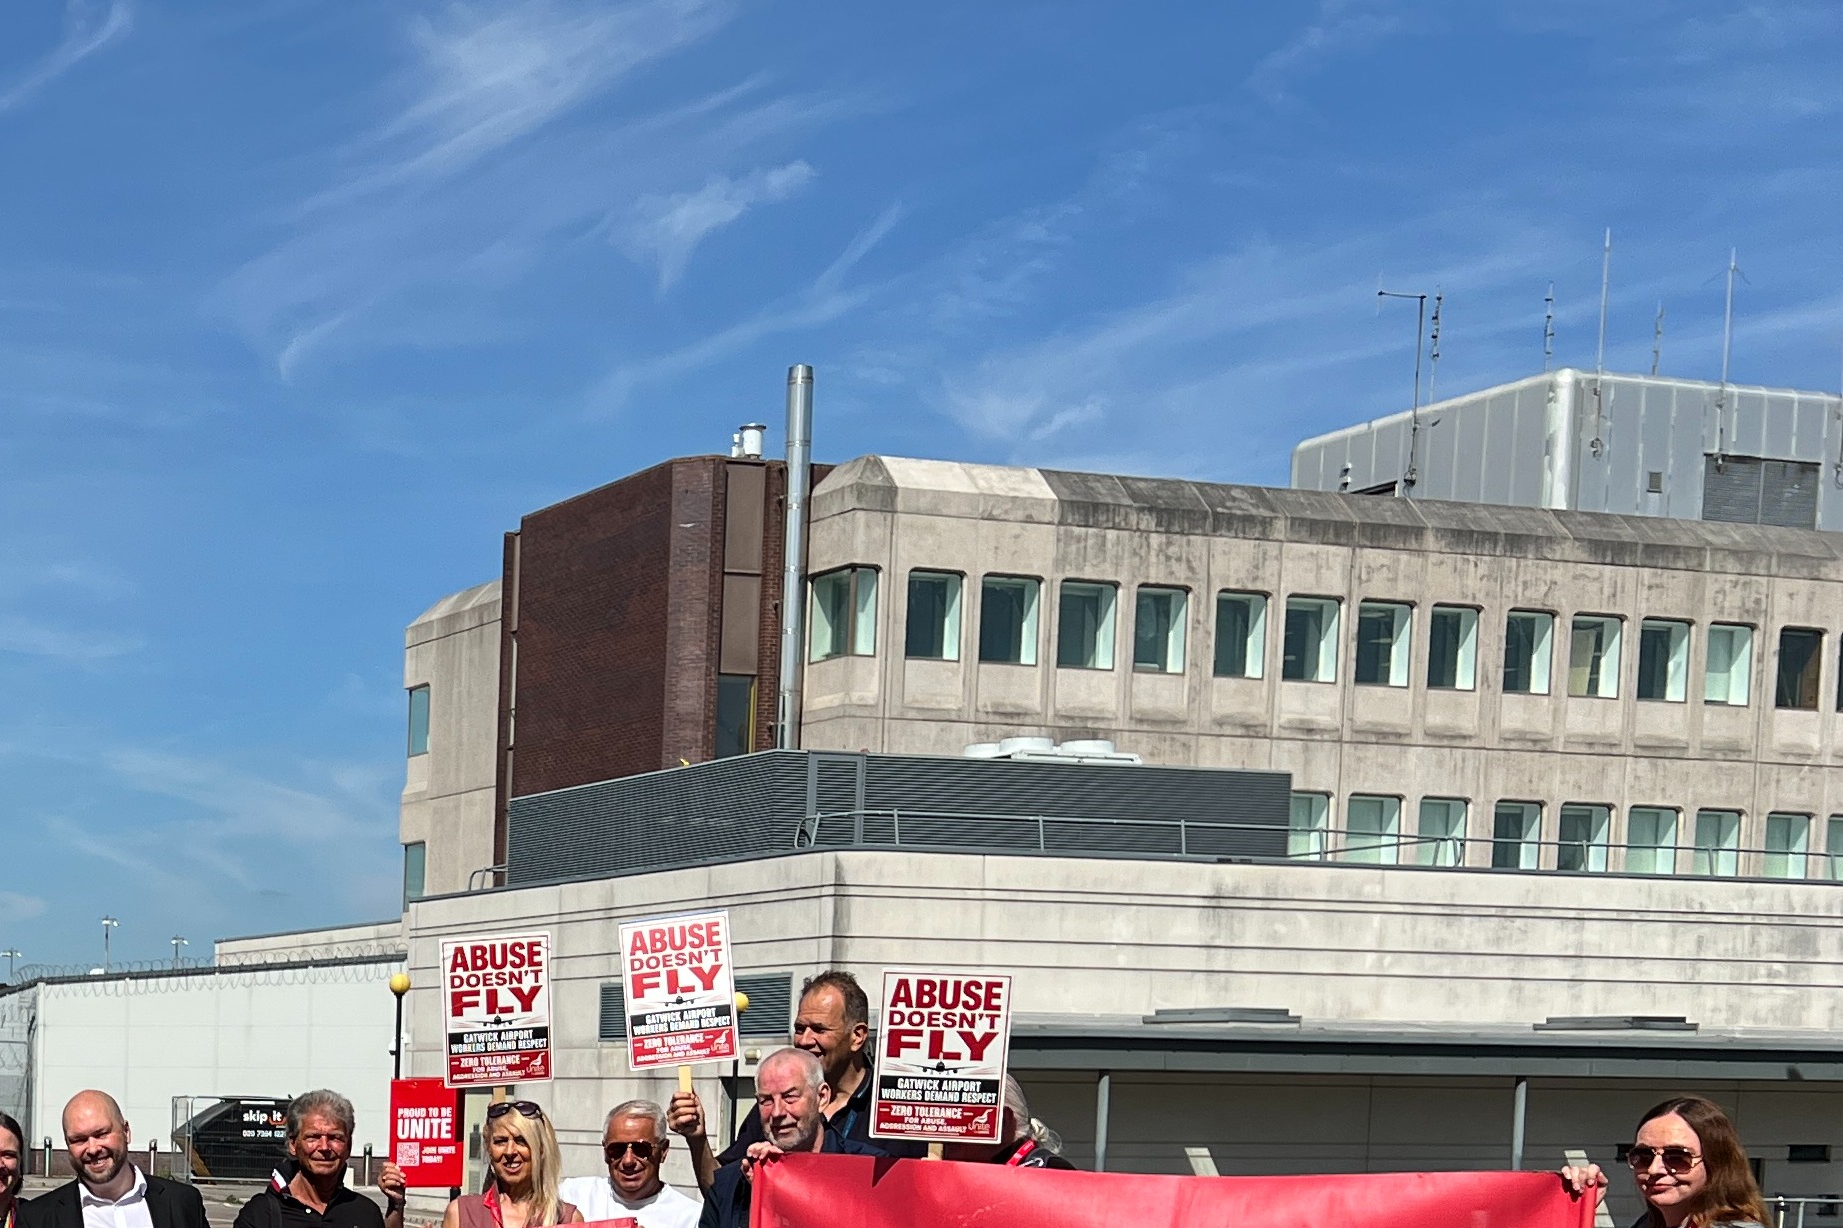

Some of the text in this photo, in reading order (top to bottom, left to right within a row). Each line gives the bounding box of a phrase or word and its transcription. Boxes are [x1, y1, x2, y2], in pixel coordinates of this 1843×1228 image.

[630, 921, 721, 956] ABUSE
[450, 941, 542, 973] ABUSE
[630, 948, 722, 971] DOESN'T
[450, 969, 543, 989] DOESN'T
[632, 964, 722, 999] FLY
[451, 985, 542, 1017] FLY
[890, 979, 1003, 1010] ABUSE
[889, 1011, 1001, 1028] DOESN'T
[887, 1029, 998, 1061] FLY
[897, 1078, 981, 1092] GATWICK AIRPORT
[882, 1089, 996, 1103] WORKERS DEMAND RESPECT
[242, 1110, 282, 1124] skip it
[398, 1107, 452, 1118] PROUD TO BE
[891, 1105, 962, 1118] ZERO TOLERANCE
[397, 1118, 452, 1139] UNITE
